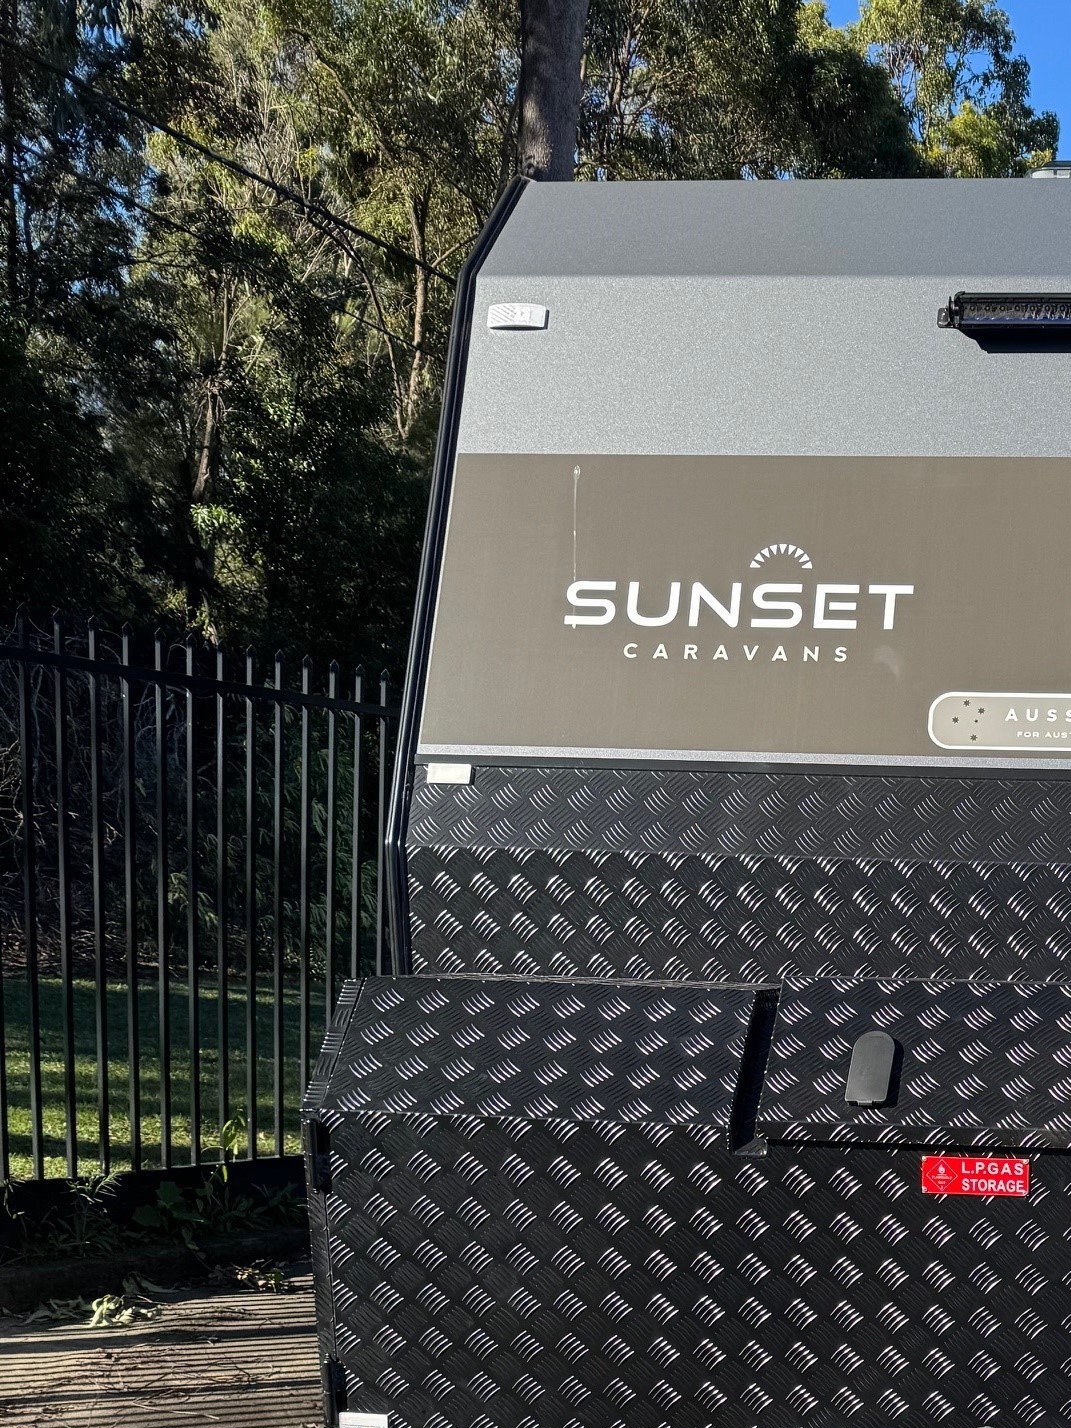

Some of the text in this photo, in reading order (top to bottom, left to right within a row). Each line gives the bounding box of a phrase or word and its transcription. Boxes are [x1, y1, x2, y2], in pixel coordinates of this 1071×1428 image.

[563, 580, 915, 630] SUNSET
[623, 643, 848, 662] CARAVANS
[1016, 730, 1041, 739] FOR
[961, 1178, 1025, 1193] STORAGE
